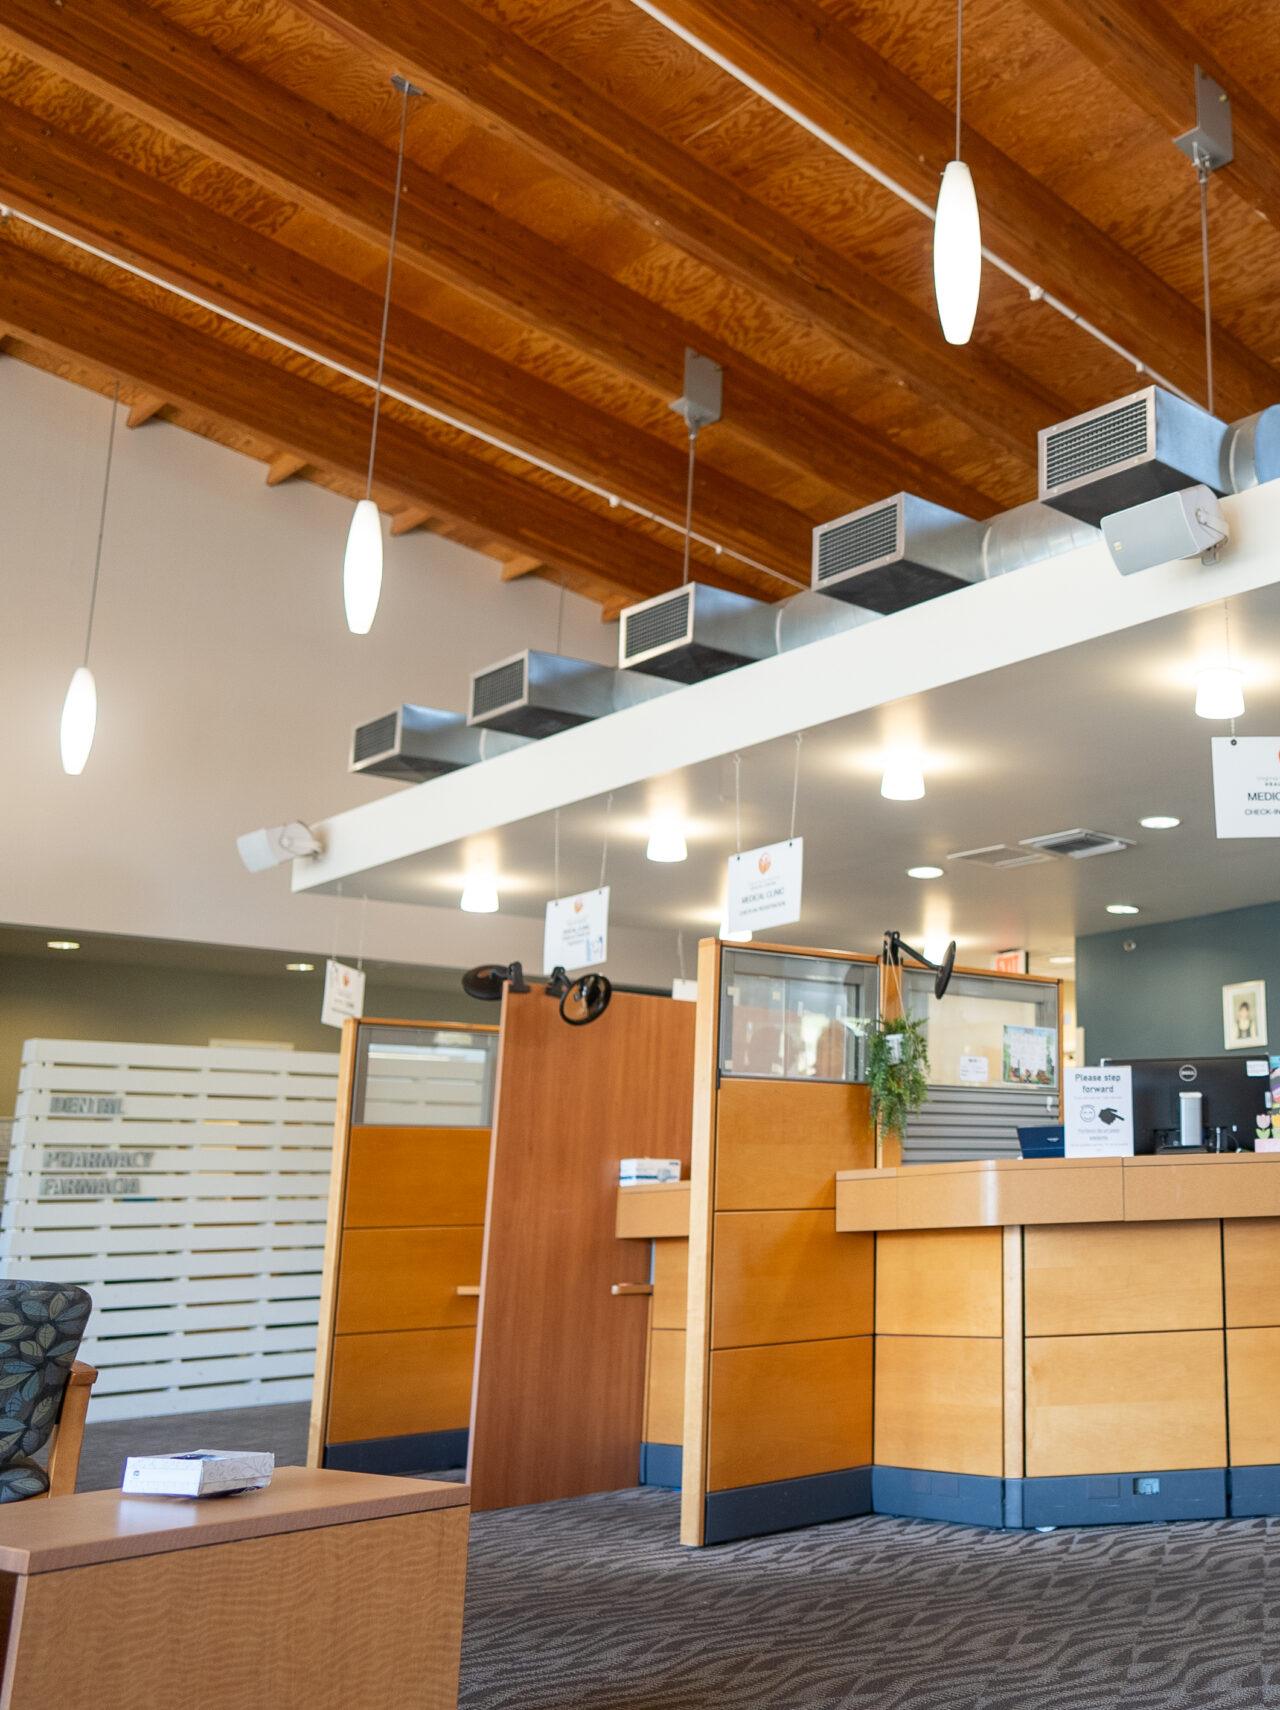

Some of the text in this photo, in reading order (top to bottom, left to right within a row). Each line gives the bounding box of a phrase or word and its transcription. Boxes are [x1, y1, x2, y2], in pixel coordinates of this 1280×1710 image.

[1075, 1073, 1121, 1083] Please step
[1082, 1085, 1114, 1093] forward
[49, 1096, 124, 1115] DENTAL
[42, 1151, 154, 1169] PHARMACY
